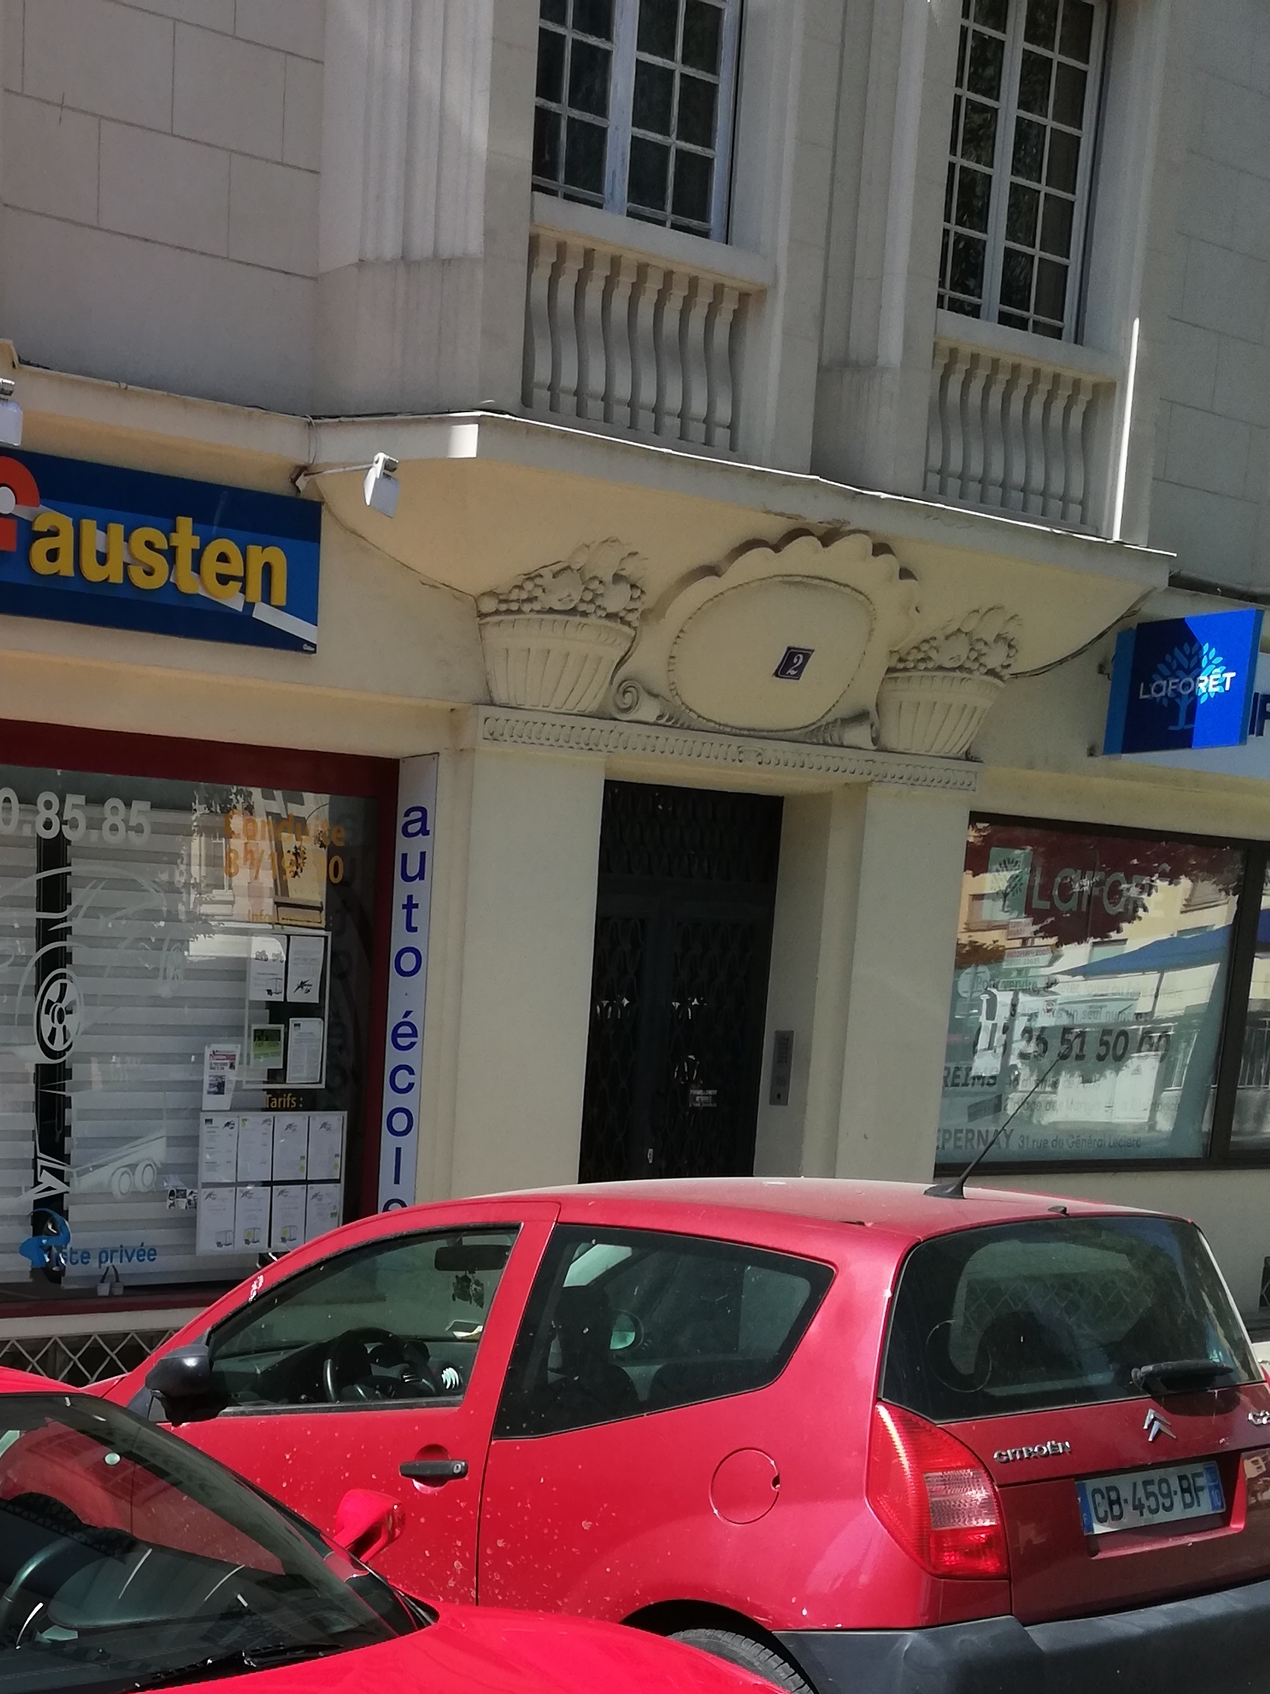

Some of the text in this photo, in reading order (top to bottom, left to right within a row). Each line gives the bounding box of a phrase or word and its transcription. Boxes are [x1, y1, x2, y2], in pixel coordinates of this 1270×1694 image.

[785, 653, 804, 676] 2
[393, 804, 430, 978] auto
[98, 1242, 158, 1269] privée
